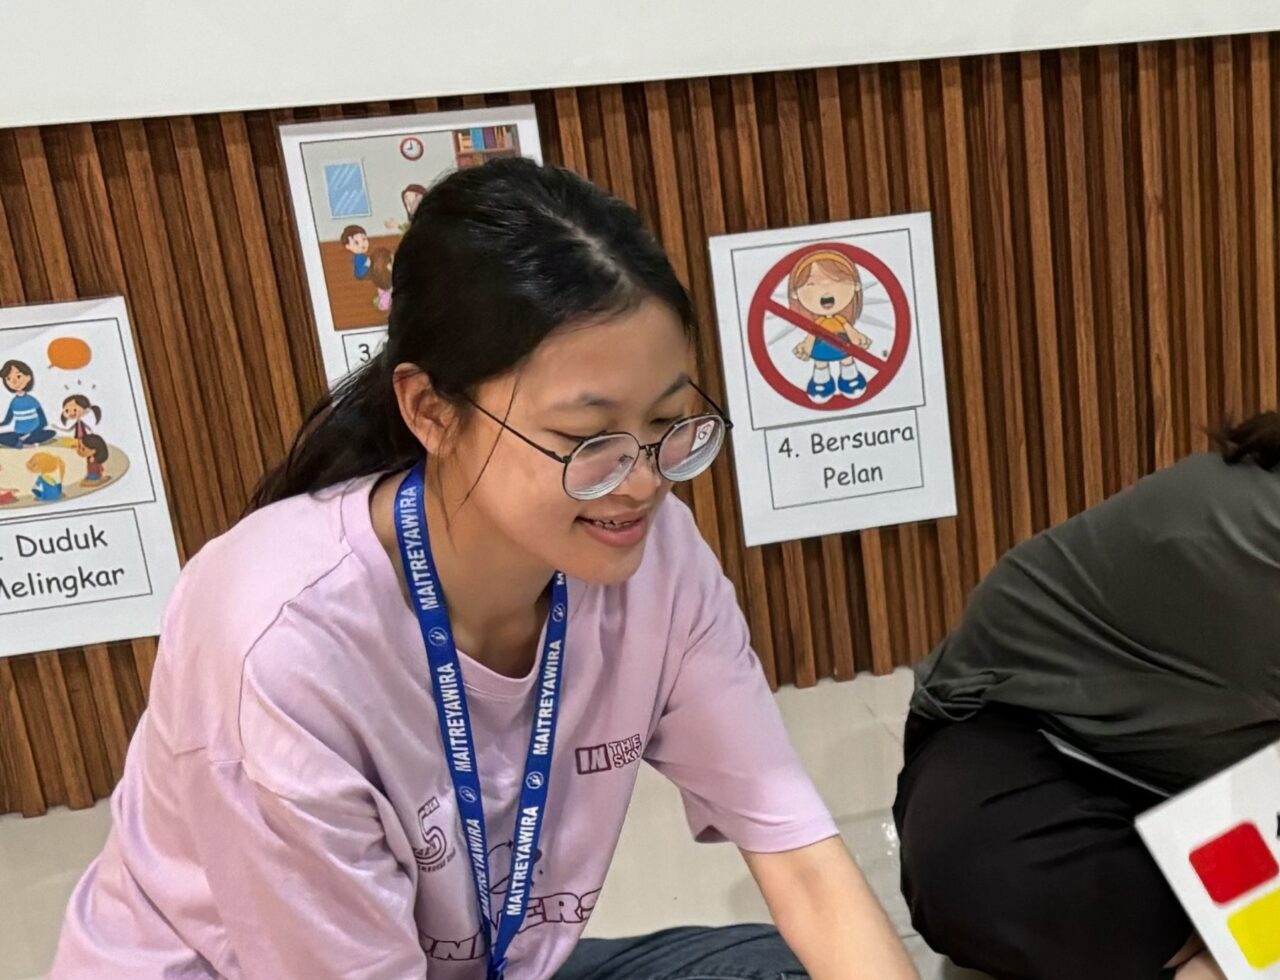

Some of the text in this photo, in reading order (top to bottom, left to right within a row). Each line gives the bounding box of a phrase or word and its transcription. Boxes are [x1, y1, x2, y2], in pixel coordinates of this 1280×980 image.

[778, 425, 915, 458] 4. Bersuara
[823, 463, 884, 489] Pelan
[16, 524, 109, 558] Duduk
[400, 485, 440, 611] MAITREYAWIRA
[437, 662, 473, 773] MAITREYAWIRA
[532, 639, 562, 756] MAITREYAWIRA
[506, 805, 540, 916] MAITREYAWIRA
